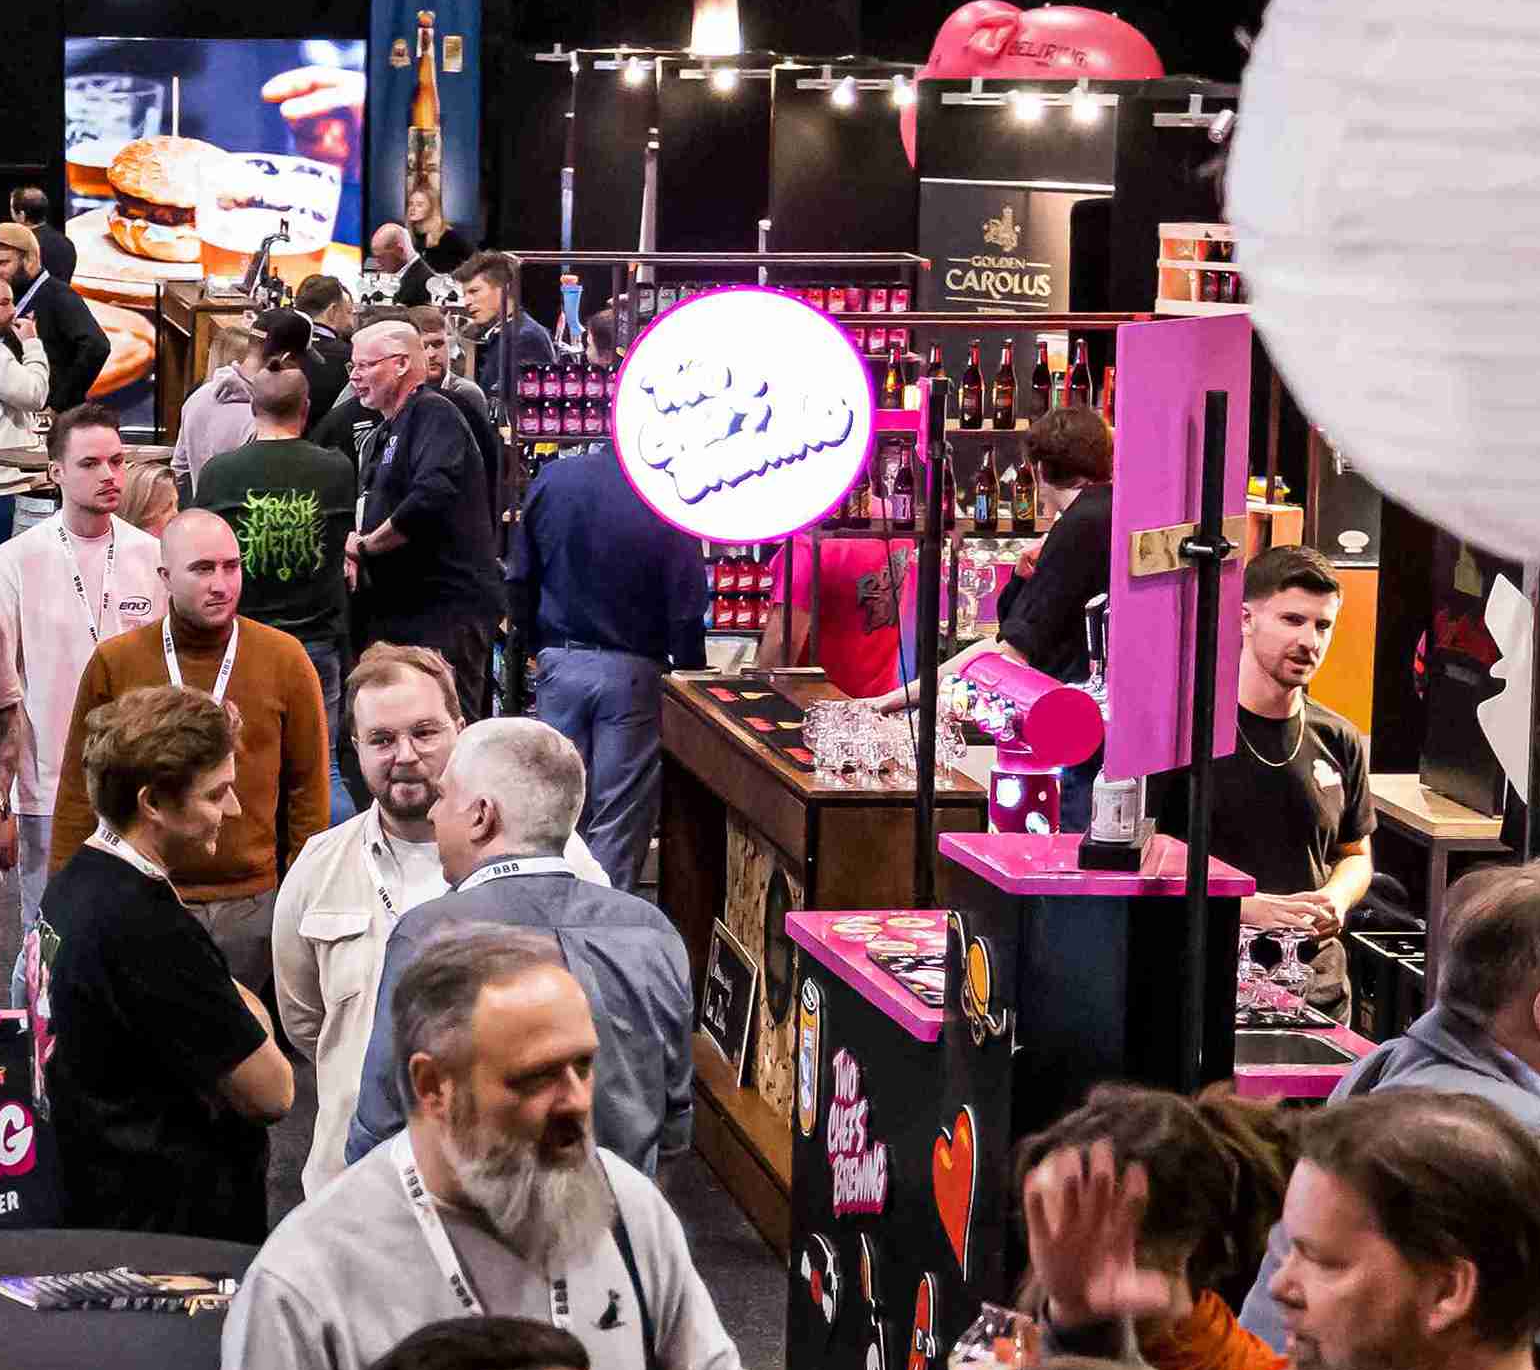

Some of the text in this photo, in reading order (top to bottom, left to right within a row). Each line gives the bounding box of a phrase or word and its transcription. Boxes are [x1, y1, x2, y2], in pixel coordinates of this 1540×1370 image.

[971, 255, 1026, 269] GOLDEN
[945, 268, 1052, 300] CAROLUS
[493, 862, 521, 875] BBB
[832, 1048, 858, 1101] TWO
[826, 1098, 868, 1154] CHEFS
[832, 1141, 887, 1210] BREWING
